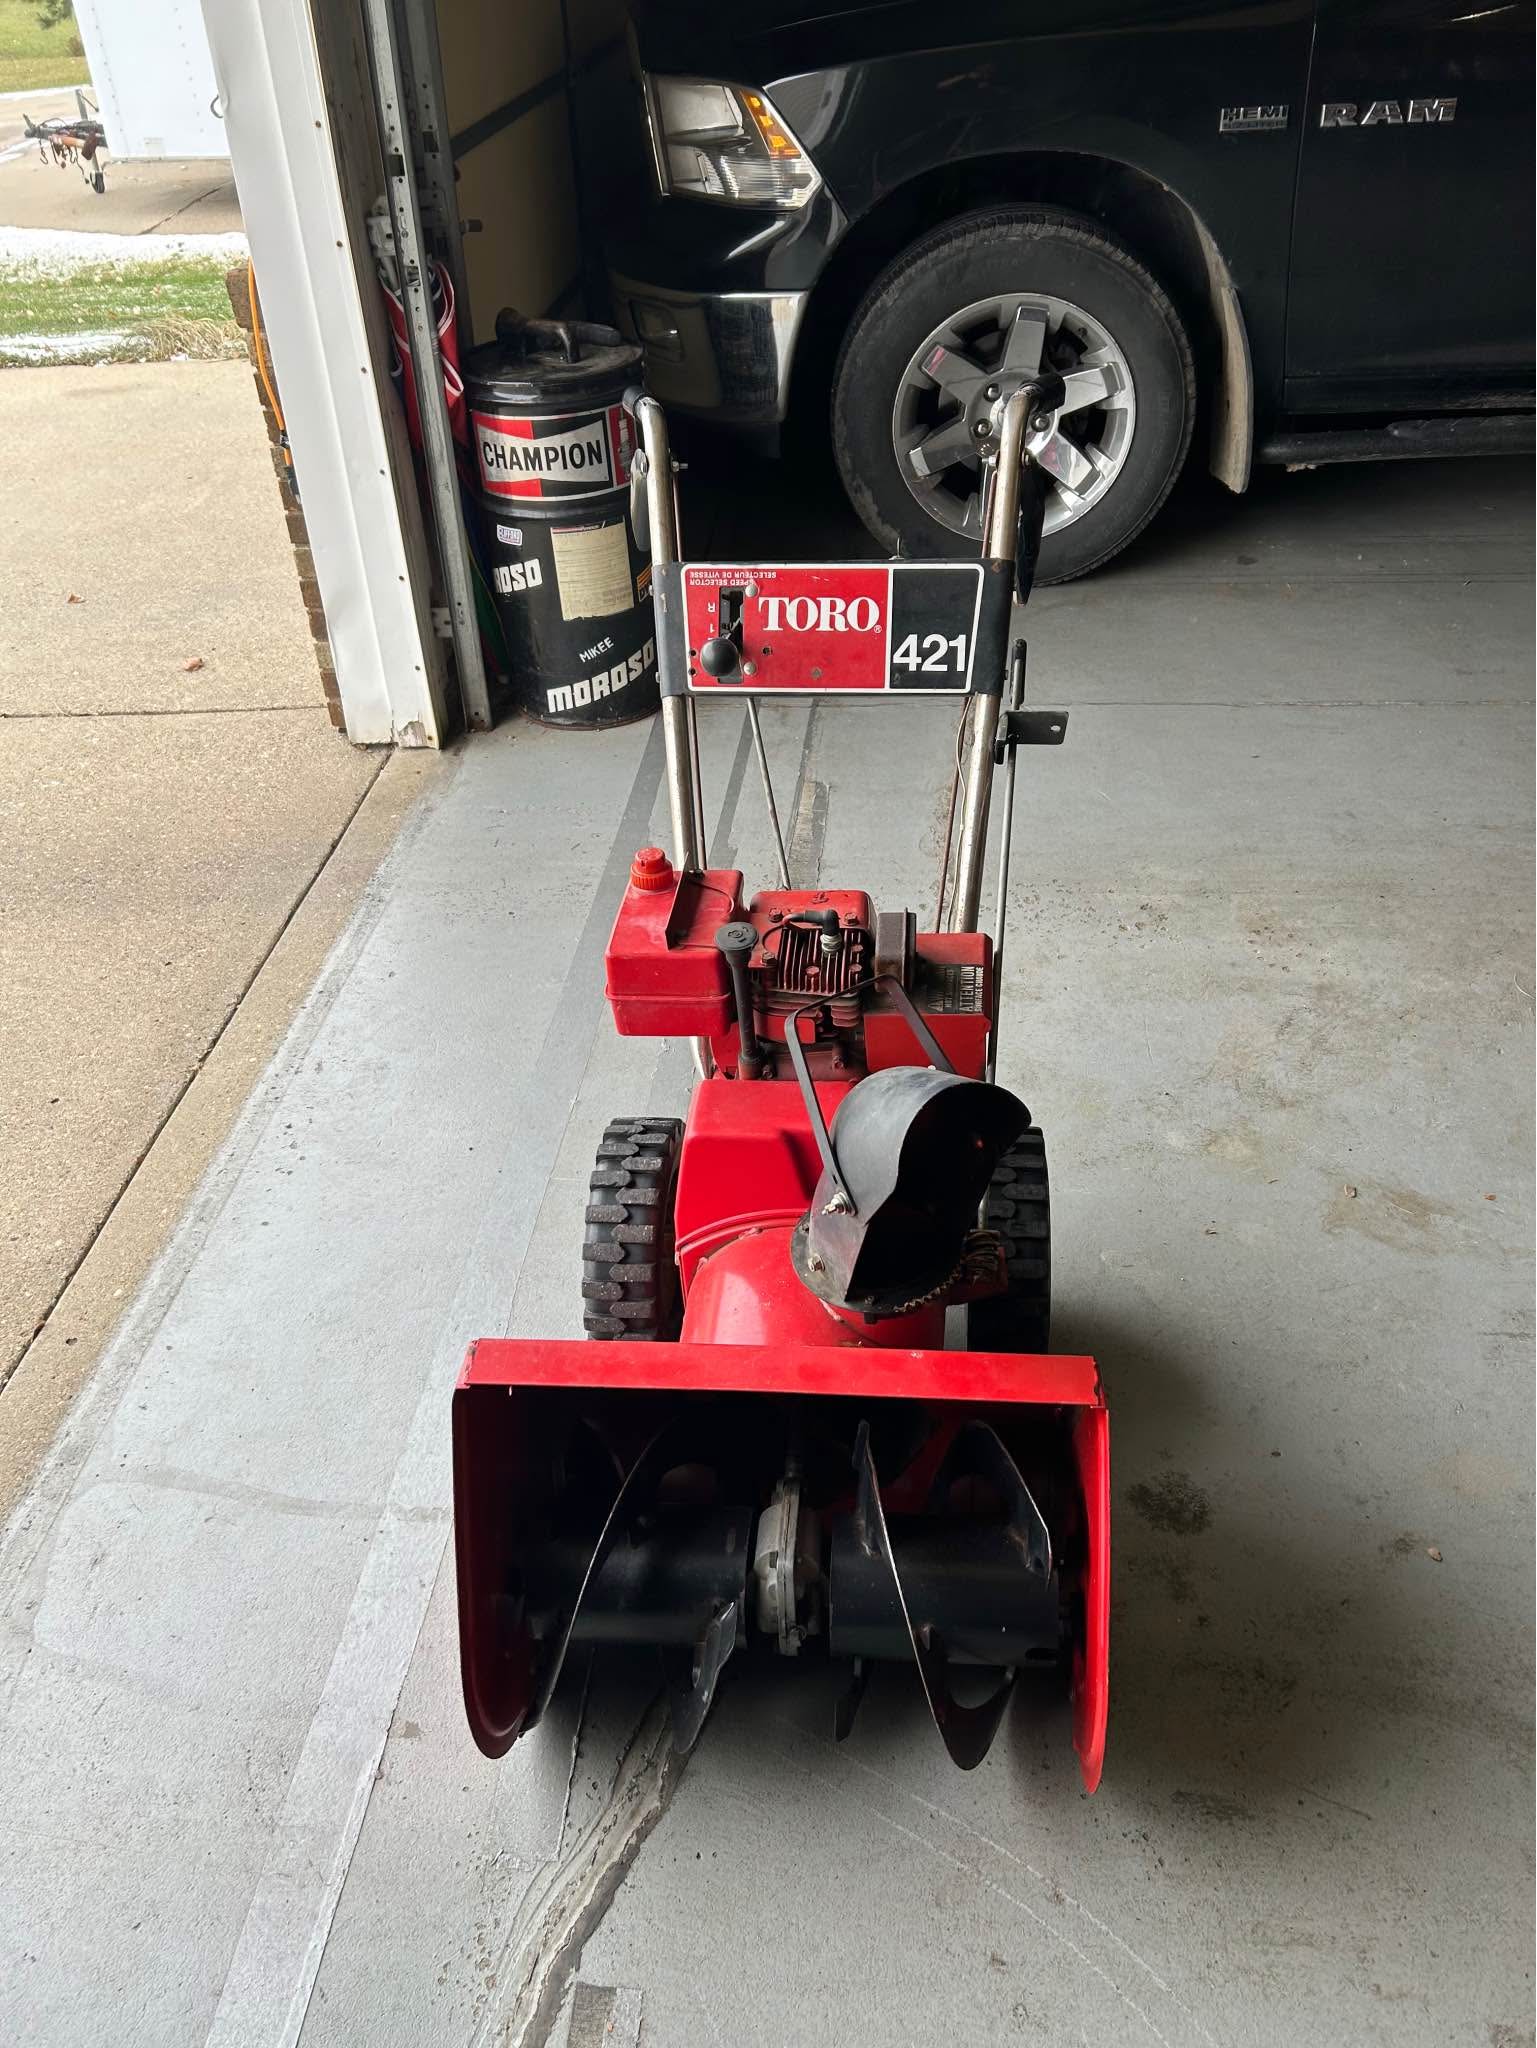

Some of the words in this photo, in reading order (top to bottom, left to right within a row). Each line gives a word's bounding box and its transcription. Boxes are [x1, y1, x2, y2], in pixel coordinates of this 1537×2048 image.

[1219, 105, 1289, 121] HEMI
[1320, 98, 1457, 127] RAM
[483, 439, 602, 471] CHAMPION
[689, 571, 720, 579] VITESSE
[689, 578, 728, 586] SELECTOR
[722, 571, 733, 579] DE
[737, 571, 777, 579] SELECTEUR
[707, 602, 716, 613] R
[758, 597, 880, 632] TORO
[579, 637, 614, 663] MIKEE
[893, 633, 967, 671] 421
[547, 637, 655, 713] MOROSO
[959, 966, 974, 1012] ATTENTION
